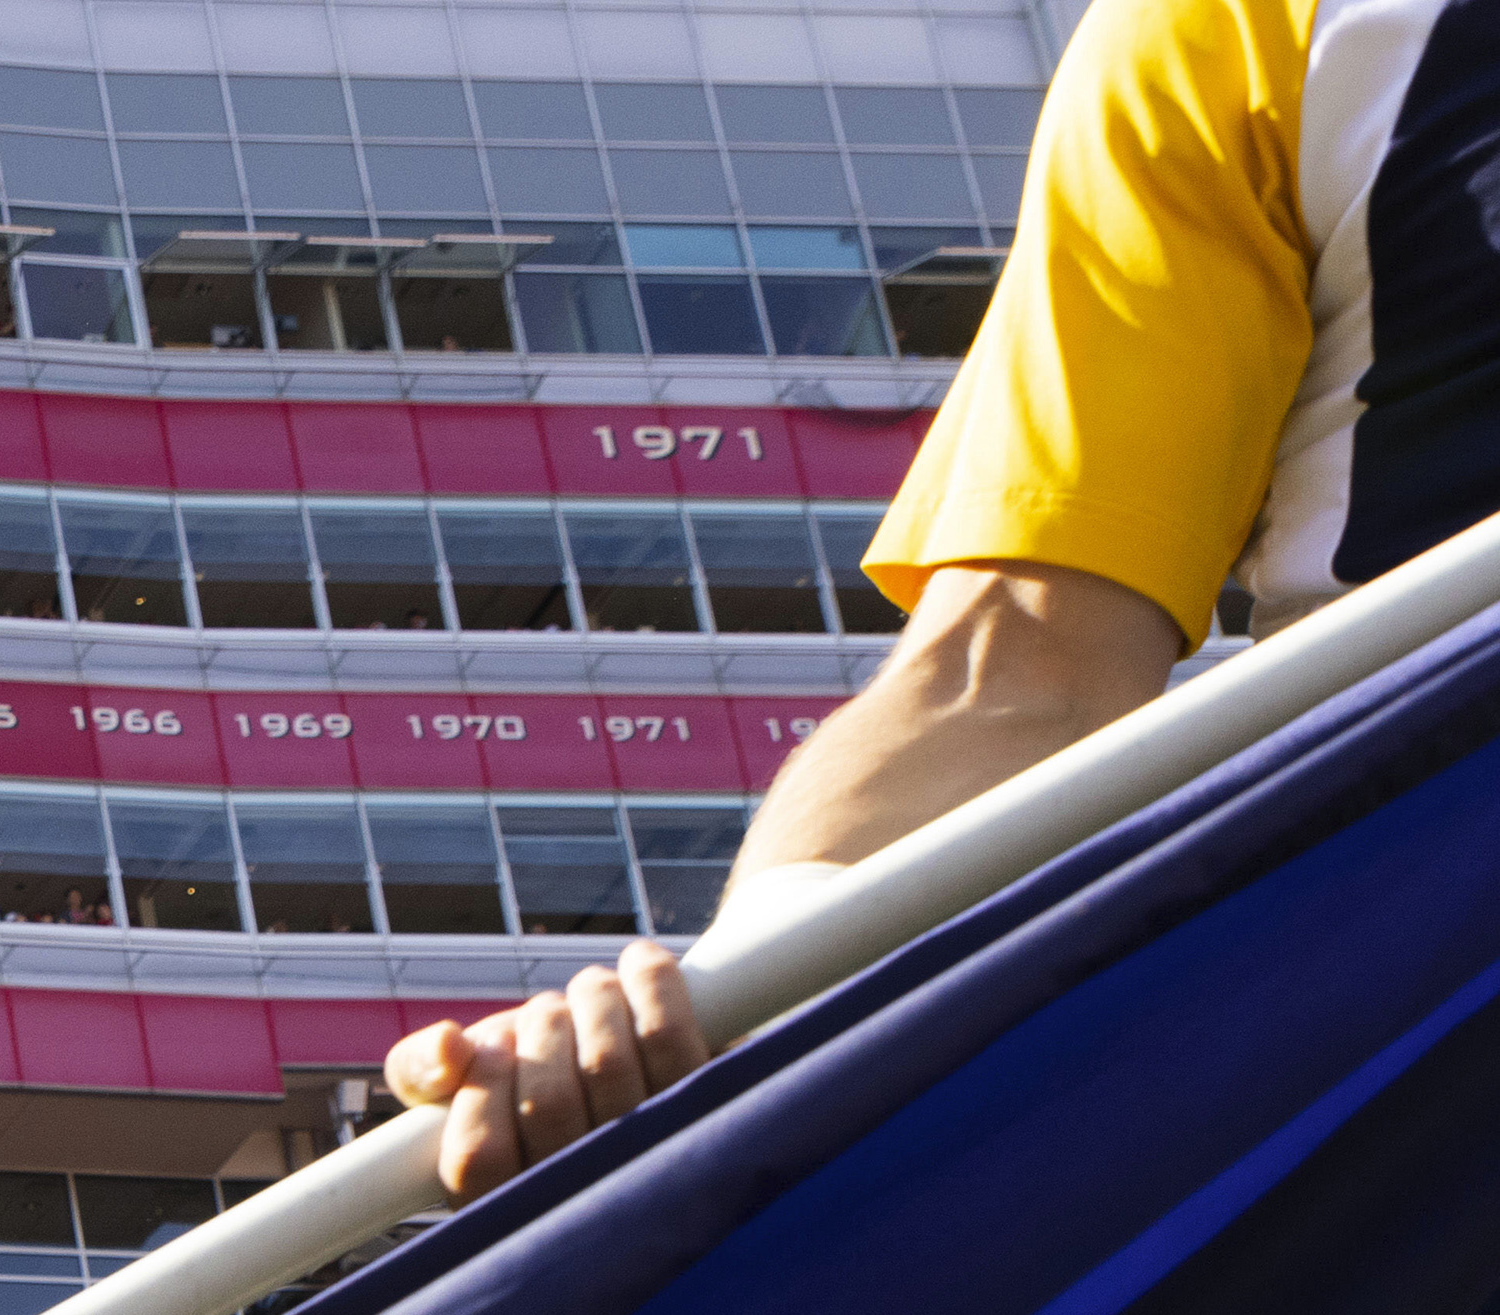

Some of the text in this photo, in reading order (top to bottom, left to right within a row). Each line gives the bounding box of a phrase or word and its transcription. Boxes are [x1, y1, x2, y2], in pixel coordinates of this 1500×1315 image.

[593, 423, 765, 462] 1971
[68, 704, 182, 736] 1966
[233, 710, 353, 739] 1969
[407, 712, 527, 742] 1970
[578, 713, 692, 743] 1971
[764, 714, 820, 743] 19
